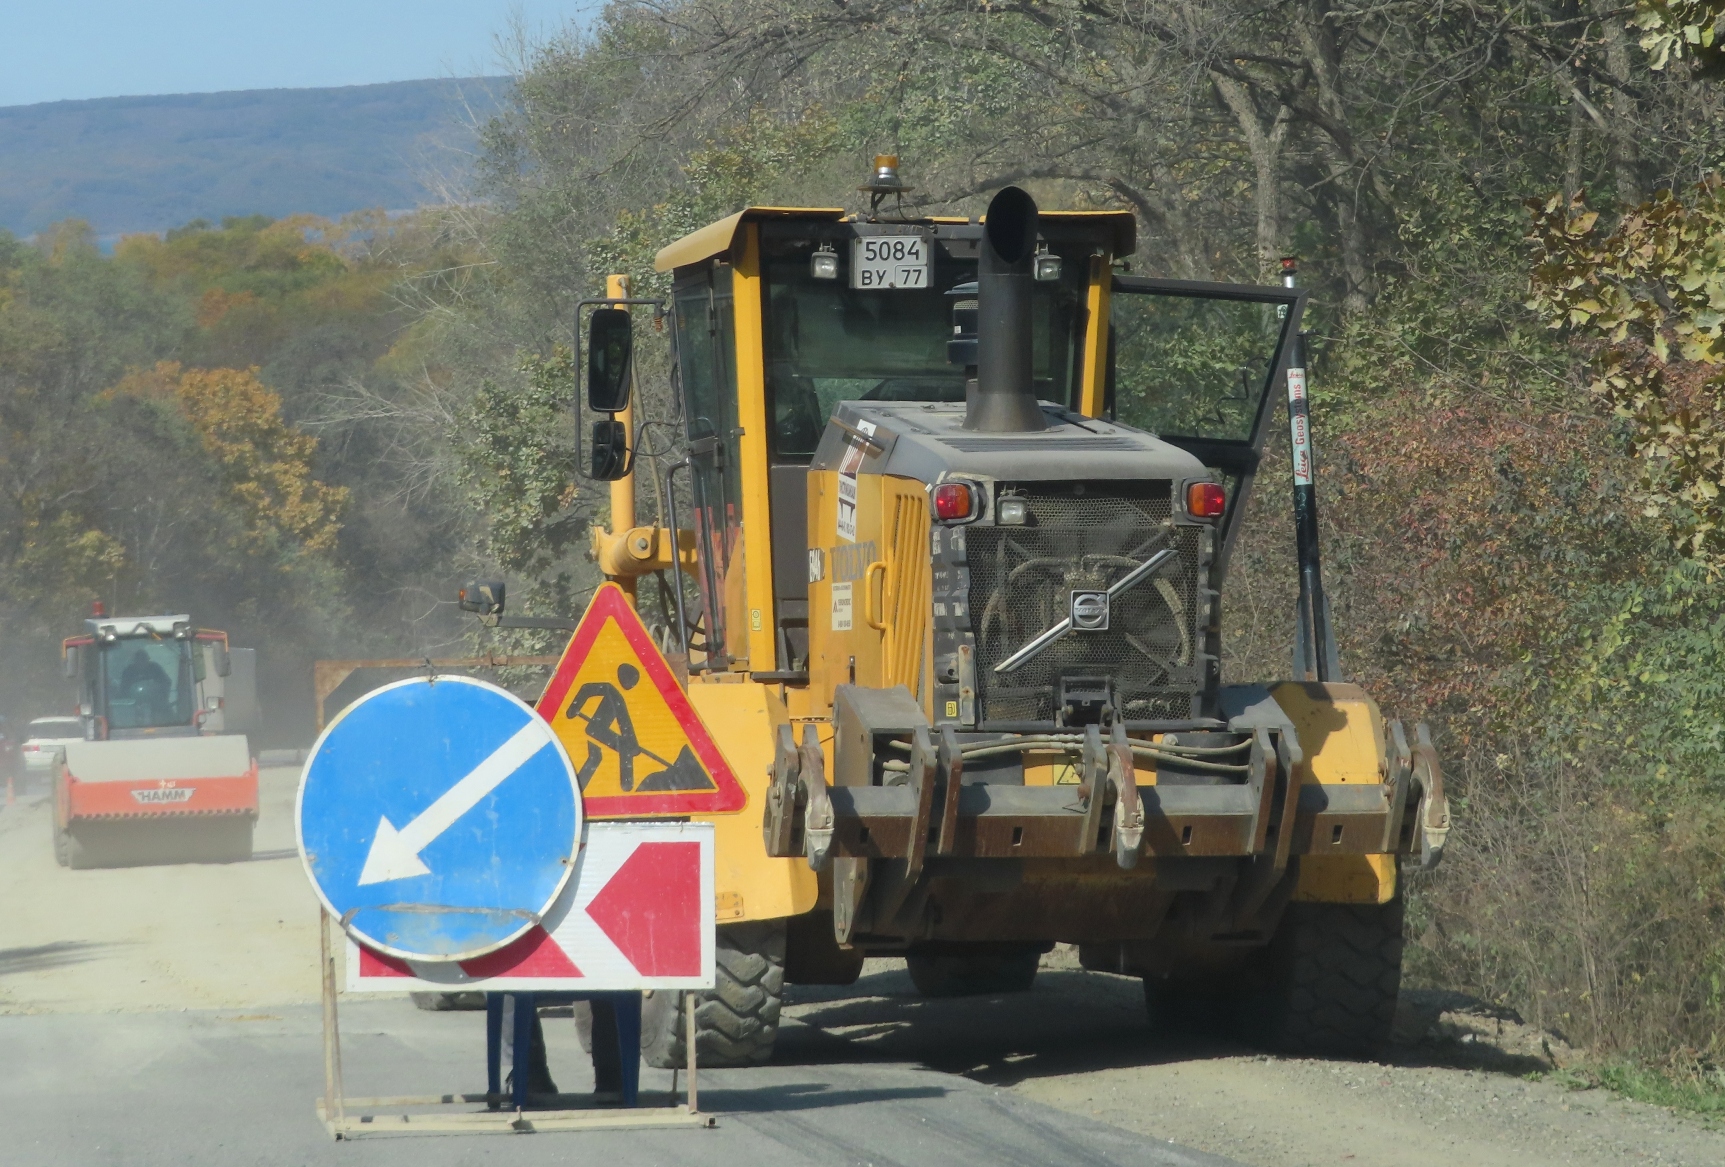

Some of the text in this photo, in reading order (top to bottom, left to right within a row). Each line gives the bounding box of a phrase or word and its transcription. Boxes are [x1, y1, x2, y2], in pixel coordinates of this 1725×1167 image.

[865, 241, 919, 261] 5084
[901, 269, 922, 285] 77
[1293, 384, 1309, 482] Leica Geosystems
[138, 790, 186, 801] HAMM
